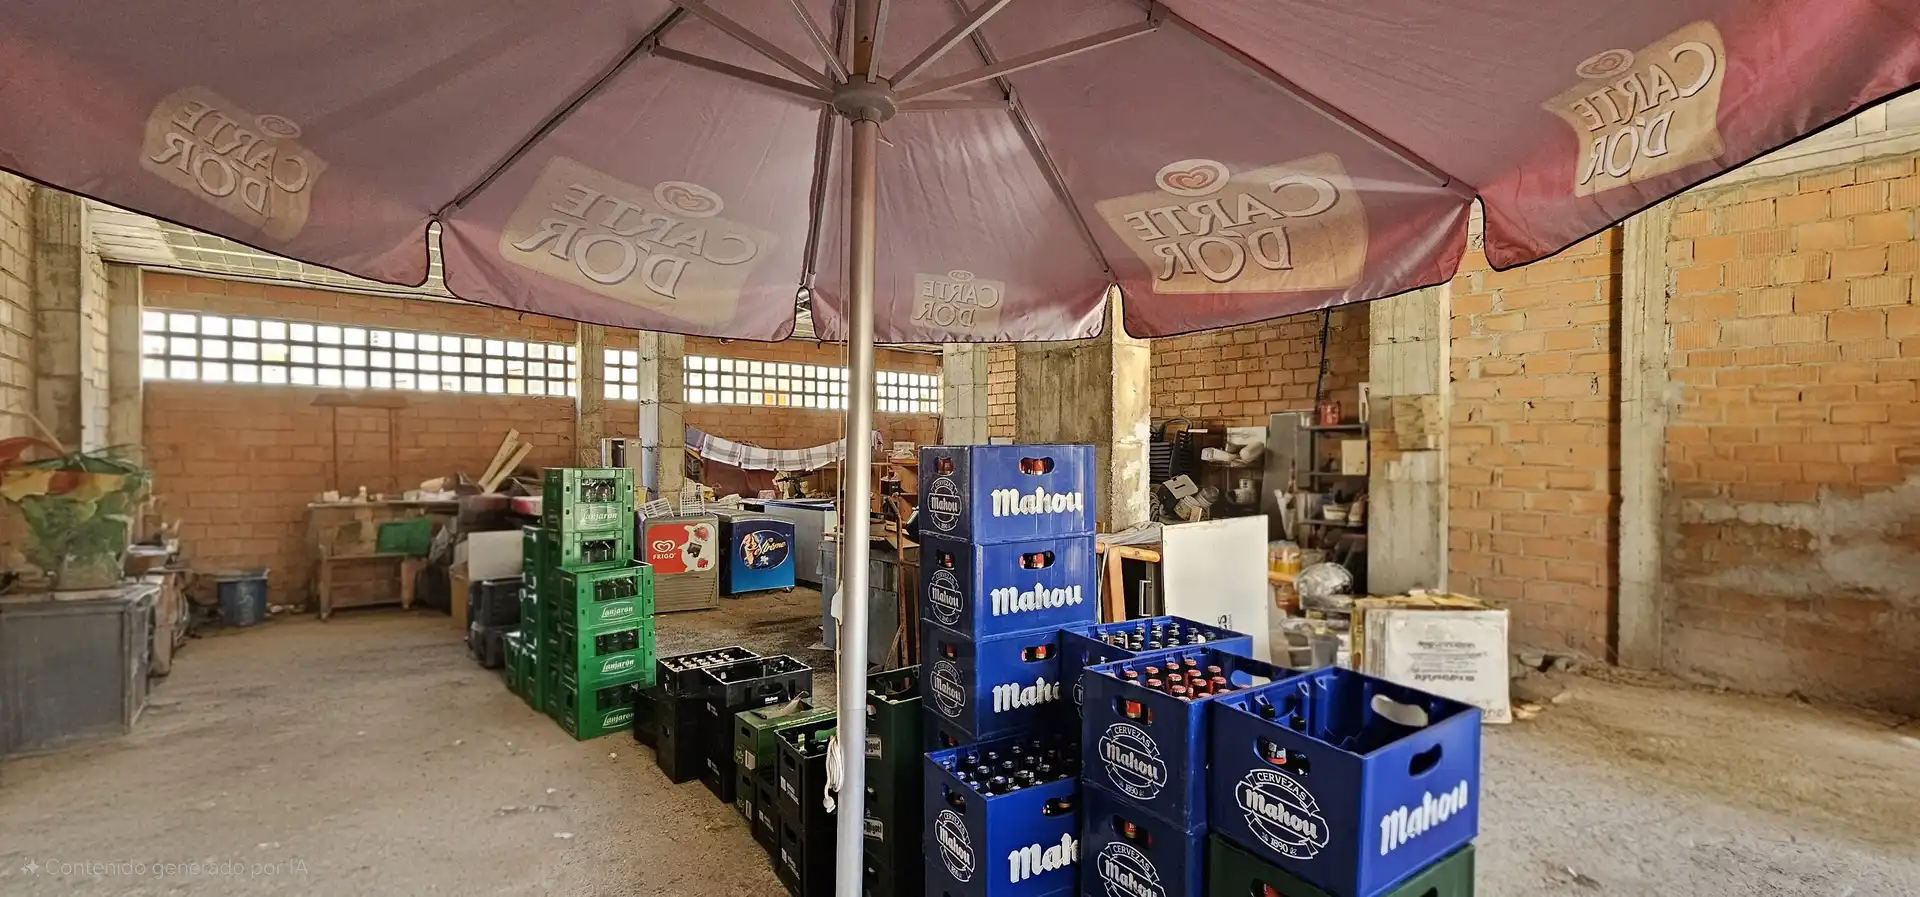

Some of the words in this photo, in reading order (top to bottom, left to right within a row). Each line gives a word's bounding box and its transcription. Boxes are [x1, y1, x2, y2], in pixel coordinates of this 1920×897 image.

[931, 496, 958, 512] Mahou
[991, 486, 1083, 517] Mahou
[931, 587, 959, 607] Mahou
[990, 582, 1083, 616] Mahou
[933, 676, 961, 702] Mahou
[992, 676, 1060, 713] Mah
[1114, 726, 1151, 747] CERVEZAS
[1106, 742, 1158, 780] Mahou
[1257, 772, 1307, 801] CERVEZAS
[1245, 788, 1318, 840] Mahou
[1380, 779, 1468, 857] Mahou
[939, 825, 970, 866] Mahou
[1008, 832, 1078, 883] Mah
[1112, 844, 1151, 872] CERVEZAS
[1270, 837, 1289, 853] 1890
